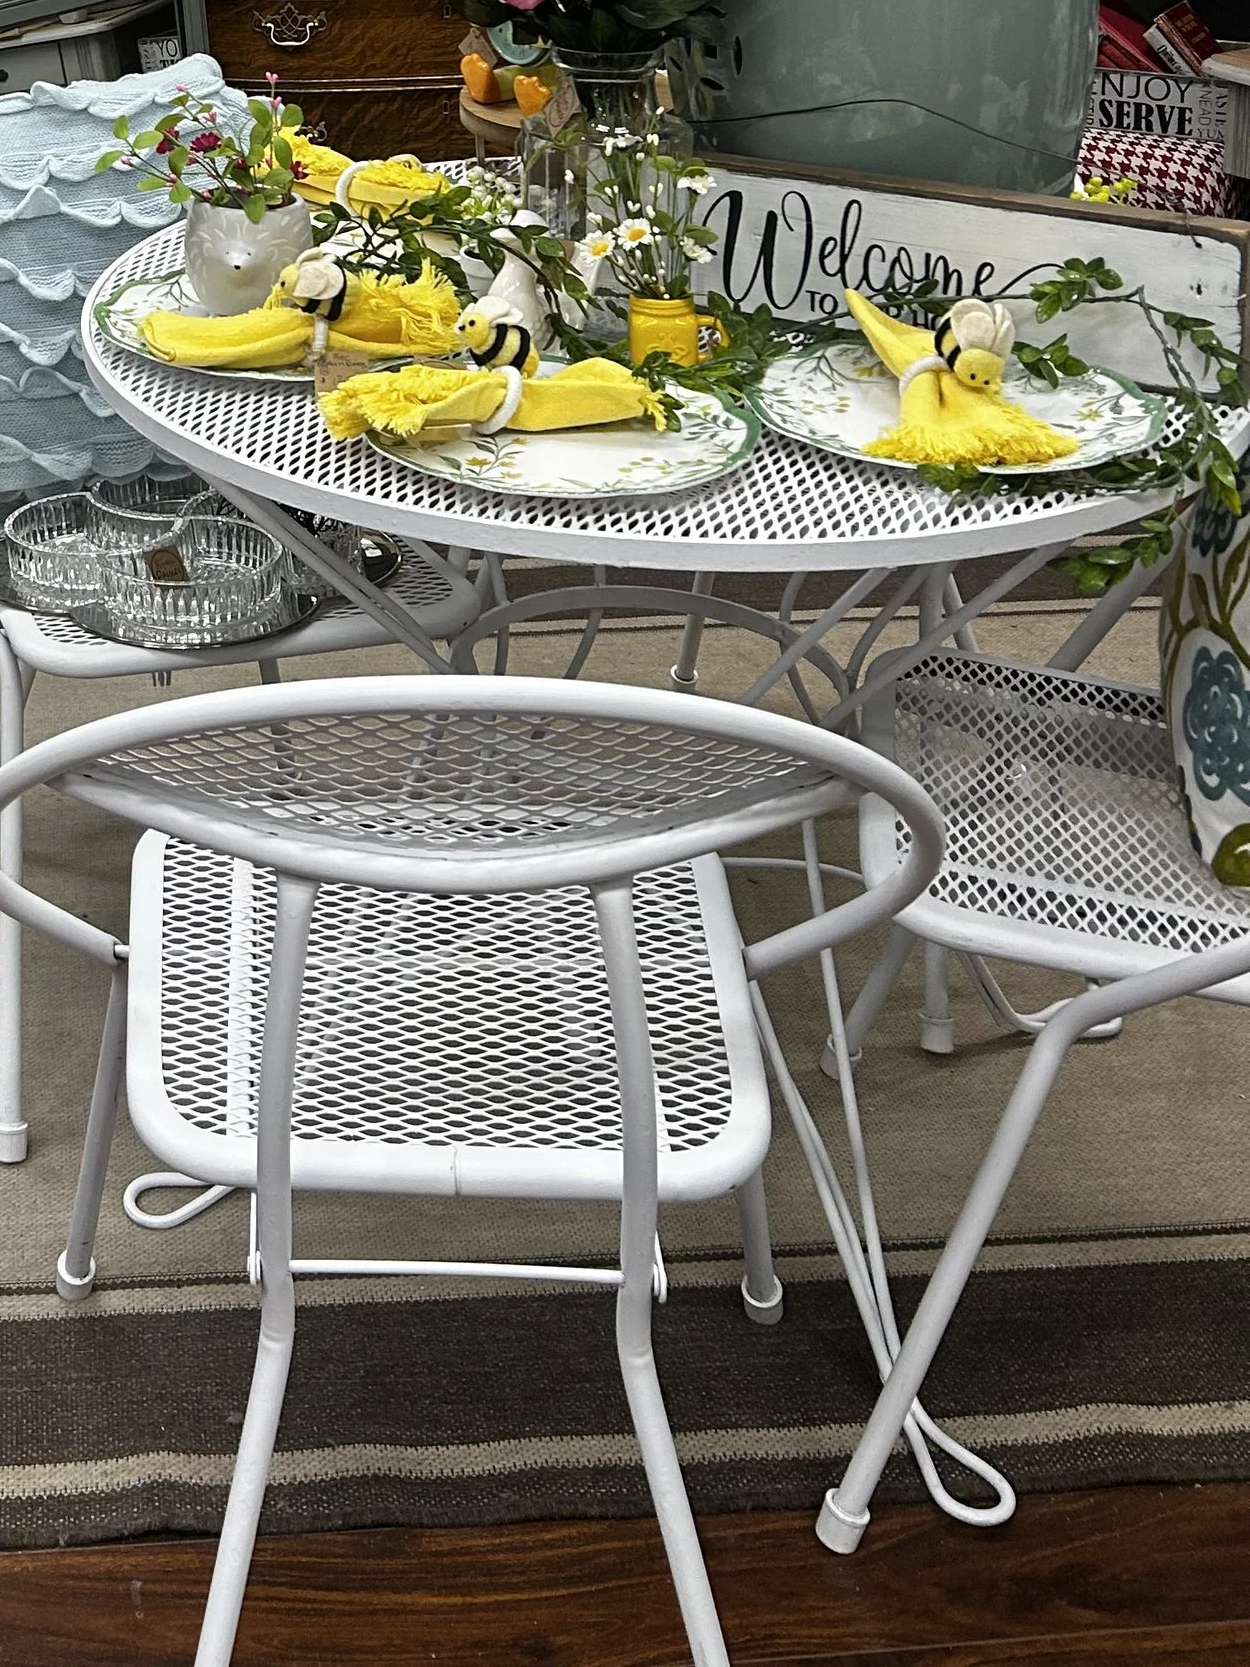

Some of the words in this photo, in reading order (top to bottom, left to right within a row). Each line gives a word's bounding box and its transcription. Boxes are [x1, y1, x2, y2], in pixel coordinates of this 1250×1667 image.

[1101, 74, 1195, 104] NJOY
[1098, 98, 1194, 136] SERVE
[702, 189, 1066, 311] Welcome
[806, 290, 839, 315] TO
